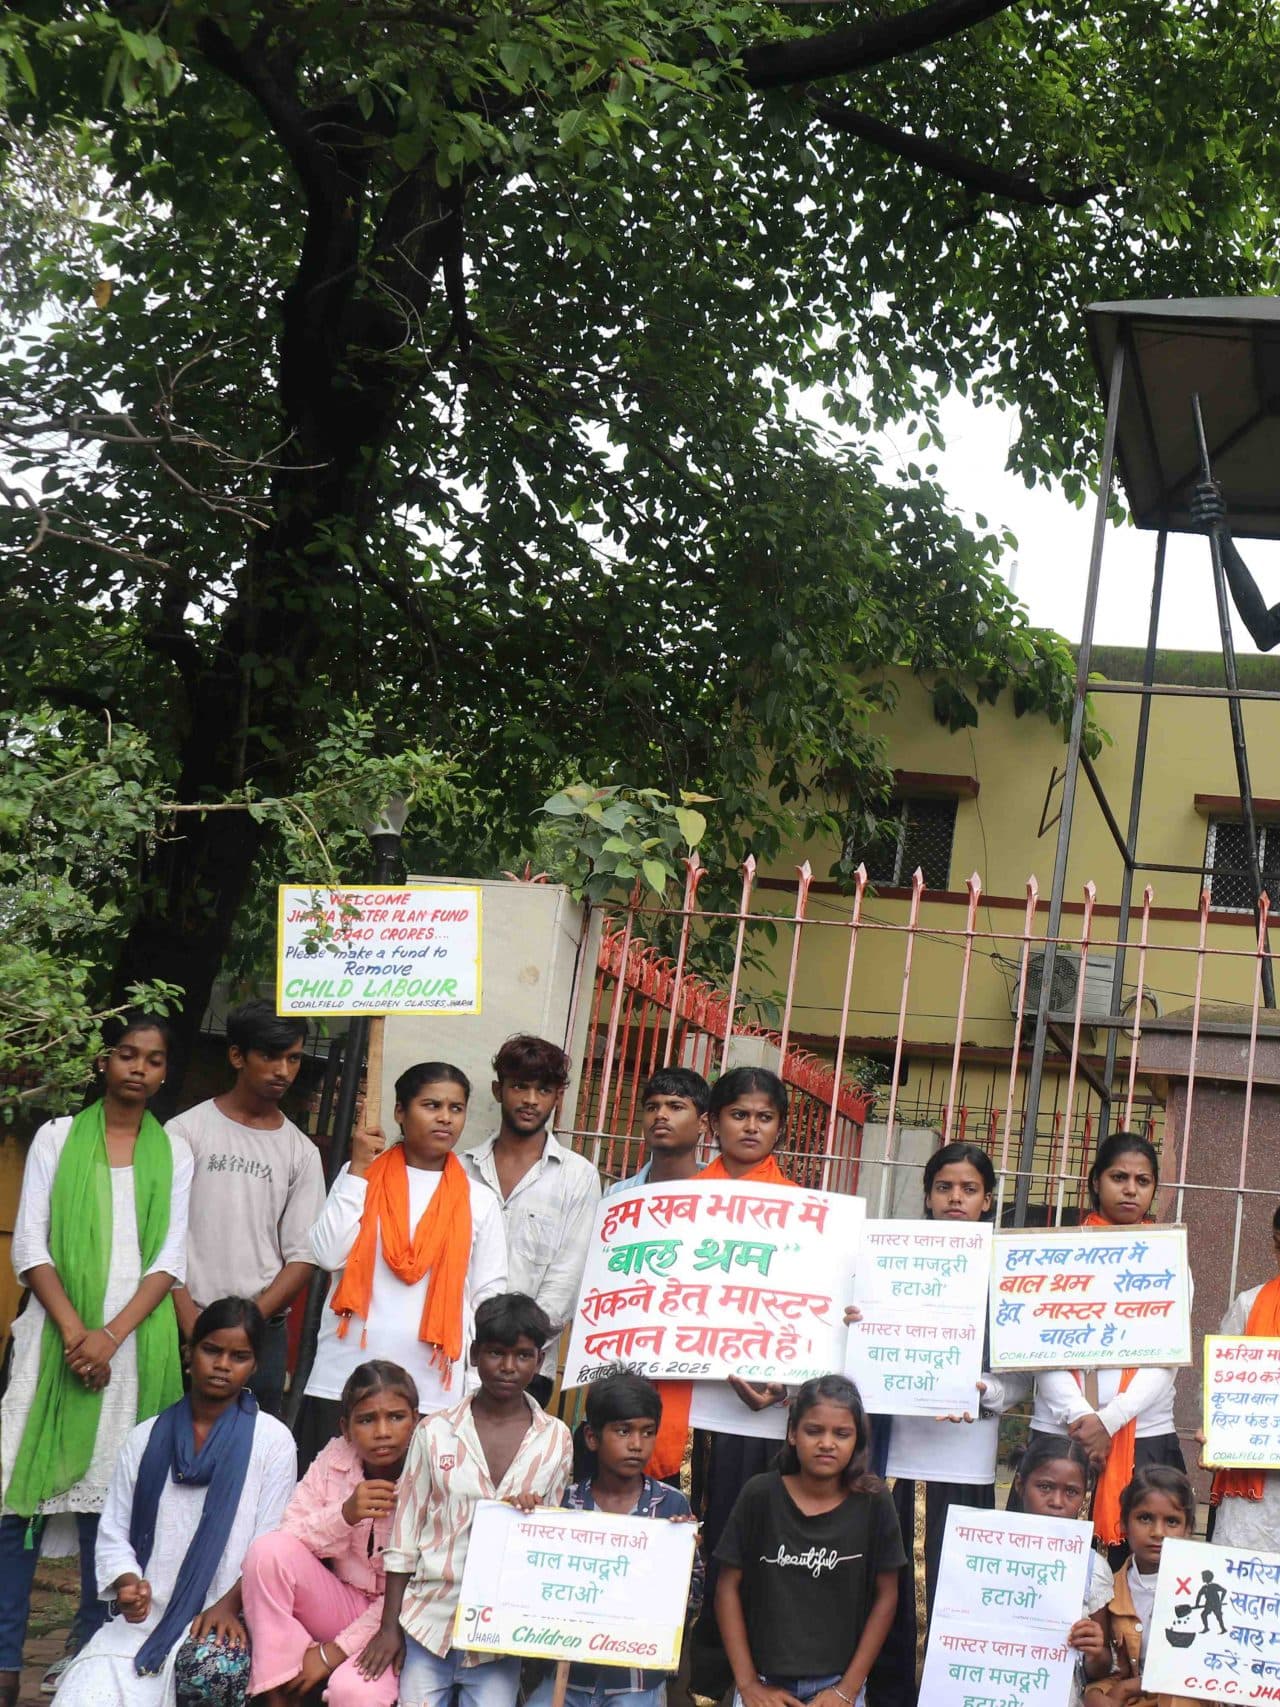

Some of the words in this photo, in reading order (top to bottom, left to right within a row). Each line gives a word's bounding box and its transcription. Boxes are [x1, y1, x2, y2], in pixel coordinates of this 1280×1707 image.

[329, 893, 411, 906] WELCOME
[391, 910, 426, 922] PLAN
[430, 910, 469, 922] FUND
[334, 946, 371, 960] make
[376, 949, 386, 959] a
[391, 946, 430, 959] fund
[433, 946, 448, 958] to
[344, 961, 413, 976] Remove
[285, 979, 353, 998] CHILD
[363, 978, 458, 998] LABOUR
[291, 1000, 344, 1009] COALFIELD
[352, 1000, 399, 1008] CHILDREN
[600, 1198, 645, 1242] हम
[648, 1195, 702, 1228] सब
[707, 1194, 793, 1229] भारत
[799, 1196, 829, 1233] में
[914, 1235, 945, 1248] प्लान
[949, 1234, 983, 1249] लाओ
[876, 1256, 909, 1270] बाल
[912, 1254, 968, 1277] मजदूरी
[1006, 1249, 1036, 1271] हम
[1035, 1248, 1073, 1265] सब
[1074, 1247, 1128, 1264] भारत
[1128, 1241, 1149, 1262] में
[1000, 1274, 1048, 1293] बाल
[1050, 1273, 1095, 1292] श्रम
[1113, 1269, 1176, 1292] रोकने
[580, 1279, 657, 1326] रोकने
[718, 1283, 833, 1326] मास्टर
[1033, 1302, 1107, 1320] मास्टर
[1114, 1300, 1176, 1318] प्लान
[584, 1326, 667, 1361] प्लान
[675, 1322, 774, 1362] चाहते
[905, 1324, 937, 1339] प्लान
[941, 1324, 976, 1340] लाओ
[1040, 1323, 1096, 1348] चाहते
[868, 1346, 900, 1362] बाल
[904, 1346, 961, 1369] मजदूरी
[1000, 1351, 1057, 1360] COALFIELD
[1063, 1349, 1114, 1359] CHILDREN
[1216, 1344, 1263, 1363] झरिया
[1214, 1370, 1257, 1383] 5940
[1251, 1393, 1278, 1405] बाल
[1249, 1433, 1269, 1446] का
[1213, 1451, 1264, 1461] COALFIELD
[571, 1528, 606, 1546] प्लान
[610, 1531, 649, 1550] लाओ
[1007, 1531, 1043, 1550] प्लान
[1046, 1535, 1084, 1554] लाओ
[527, 1550, 563, 1569] बाल
[567, 1553, 631, 1581] मजदूरी
[777, 1544, 838, 1578] beautiful
[965, 1554, 1002, 1575] बाल
[1005, 1559, 1067, 1585] मजदूरी
[512, 1626, 582, 1649] Children
[588, 1633, 658, 1656] Classes
[1230, 1625, 1264, 1653] बाल
[992, 1641, 1027, 1658] प्लान
[1030, 1643, 1069, 1663] लाओ
[948, 1663, 985, 1682] बाल
[988, 1667, 1050, 1693] मजदूरी
